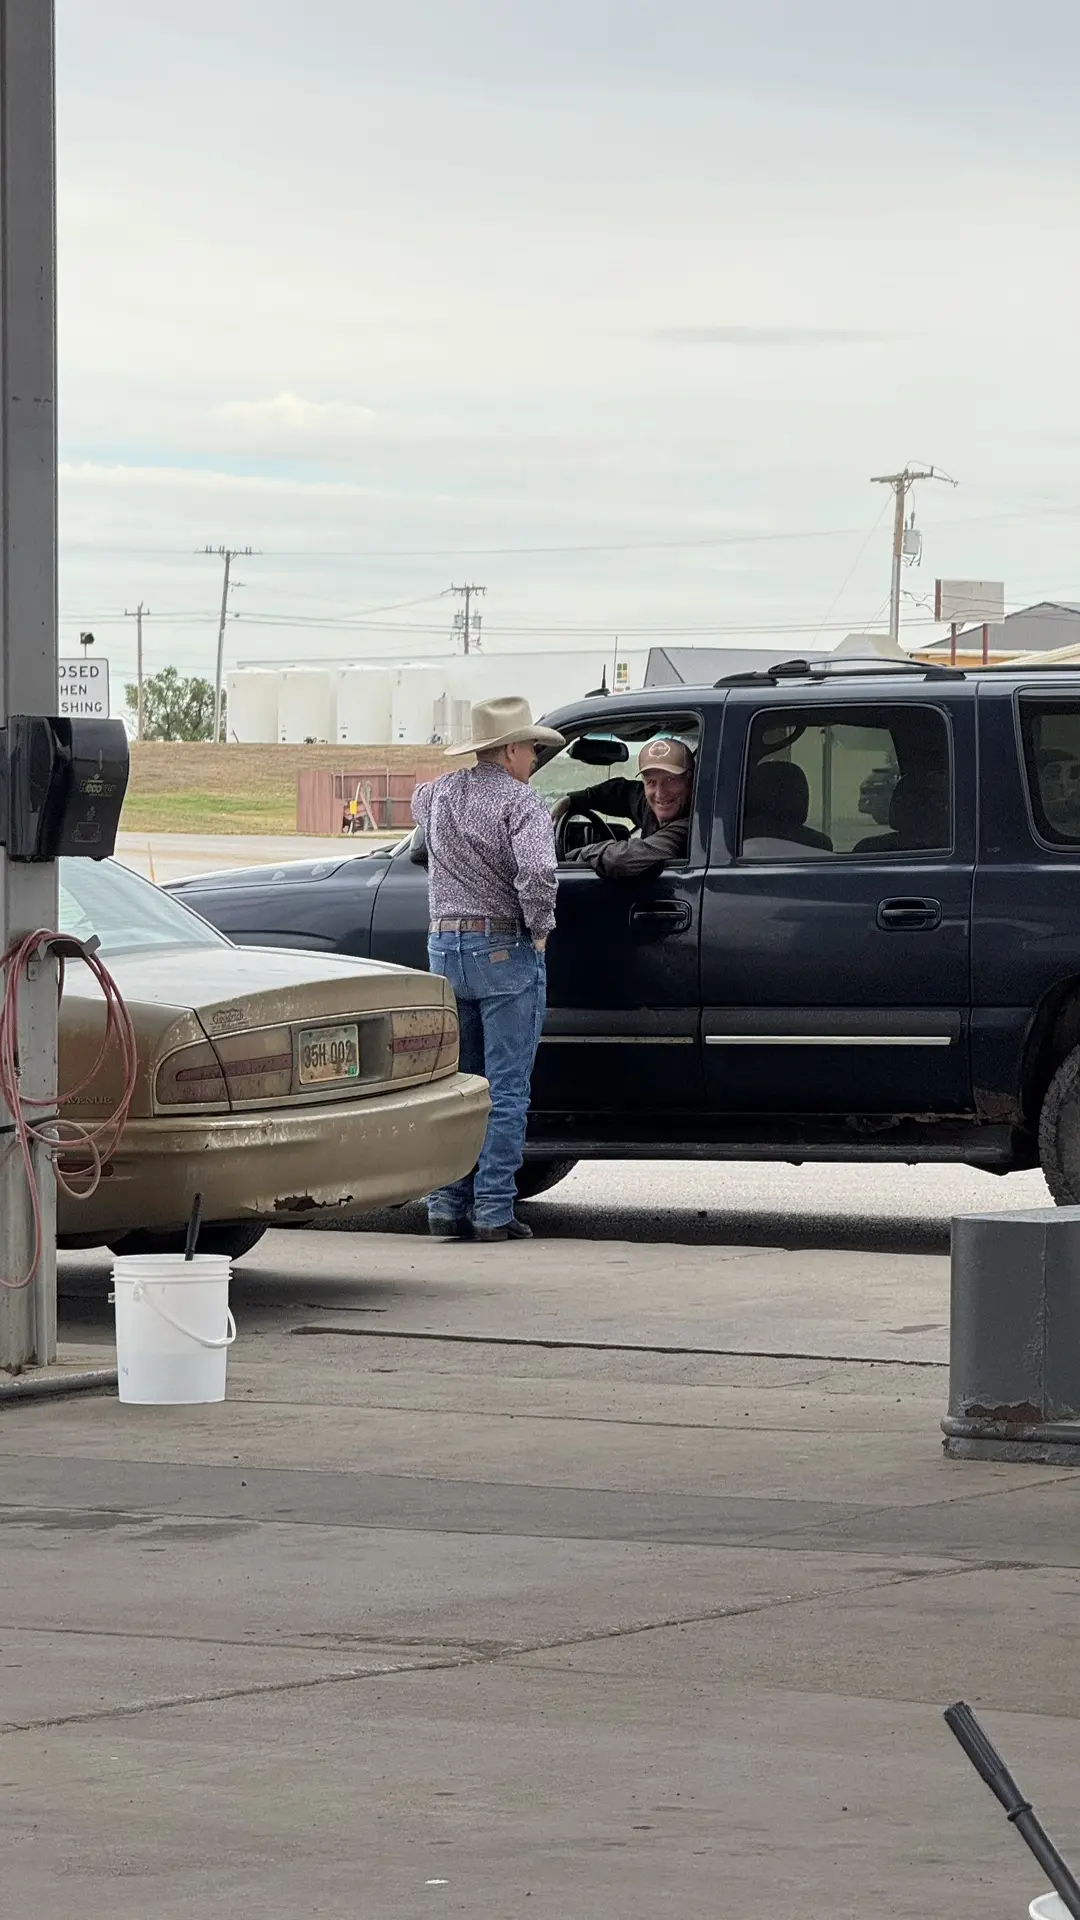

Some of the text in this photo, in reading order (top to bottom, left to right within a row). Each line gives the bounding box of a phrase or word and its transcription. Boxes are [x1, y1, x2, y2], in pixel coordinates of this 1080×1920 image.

[58, 665, 100, 678] OSED
[60, 684, 87, 696] HEN
[61, 701, 103, 713] SHING
[304, 1042, 327, 1069] 35H
